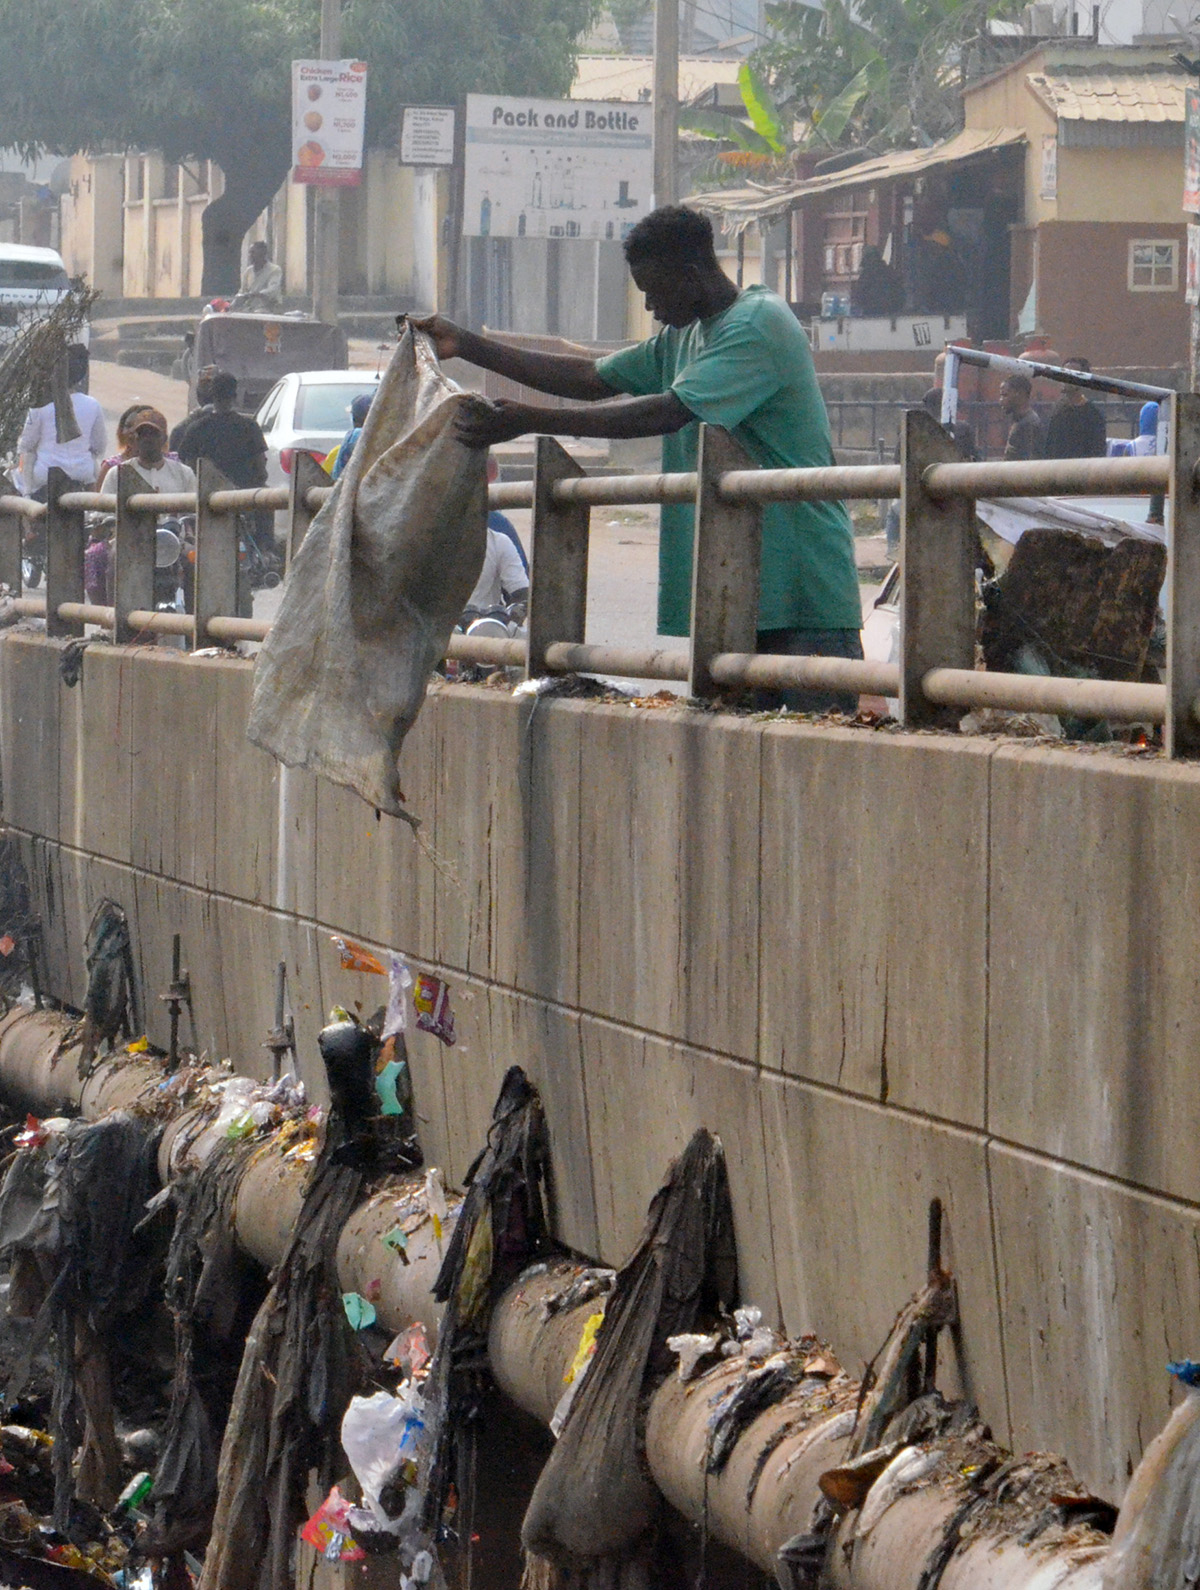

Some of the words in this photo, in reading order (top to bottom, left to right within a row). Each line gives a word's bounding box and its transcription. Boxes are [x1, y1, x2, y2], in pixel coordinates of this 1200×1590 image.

[339, 72, 363, 83] Rice
[492, 106, 538, 127] Pack
[544, 110, 579, 128] and
[585, 110, 639, 131] Bottle
